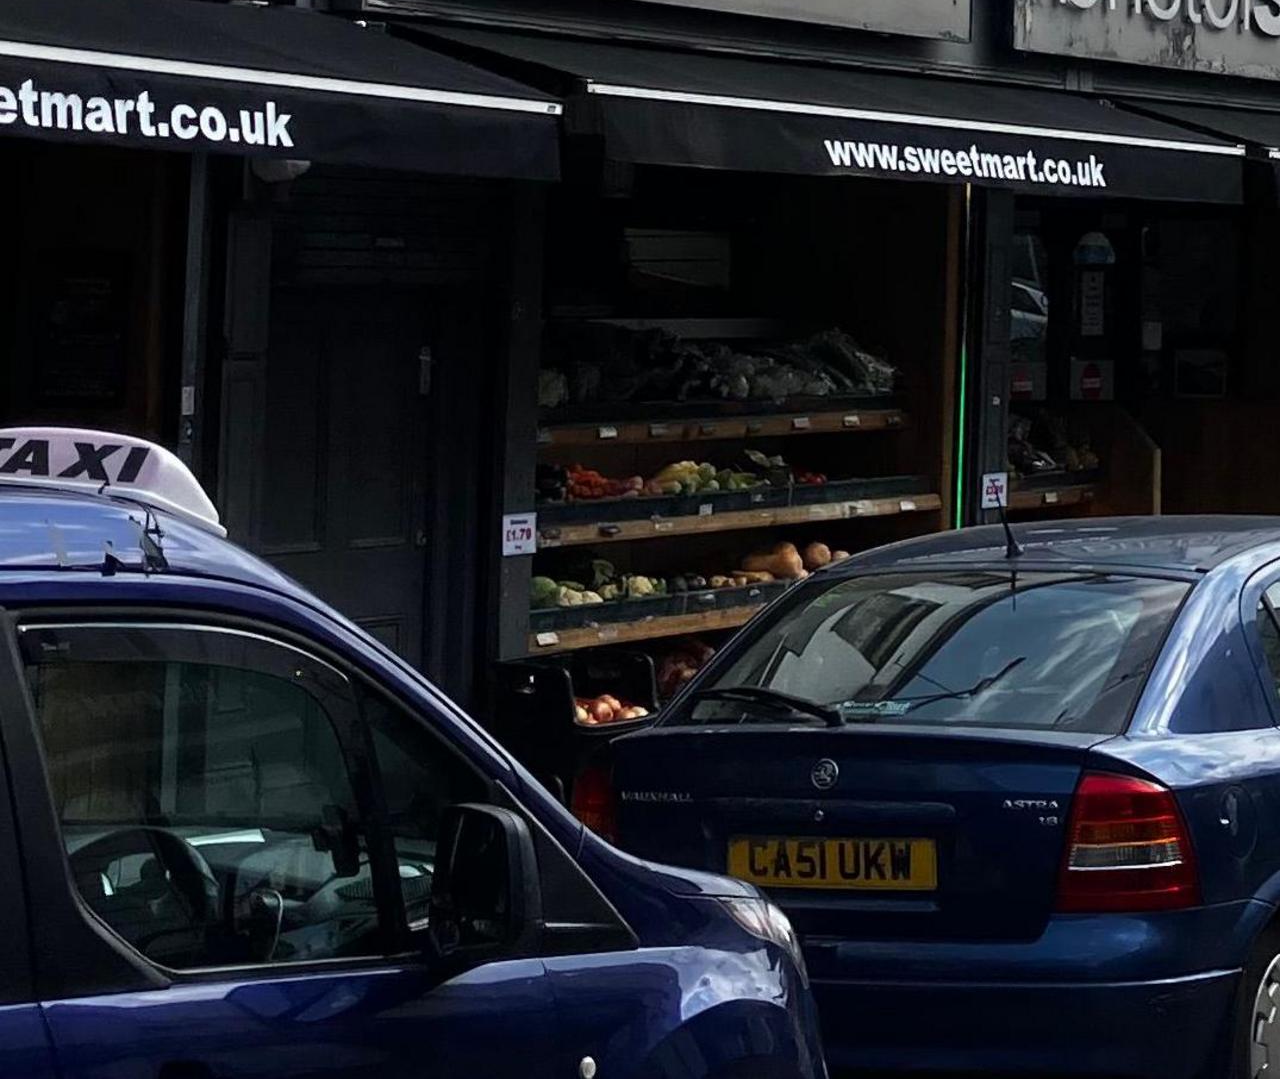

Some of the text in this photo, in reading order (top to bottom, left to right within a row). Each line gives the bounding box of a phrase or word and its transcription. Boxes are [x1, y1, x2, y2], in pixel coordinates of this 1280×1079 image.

[824, 140, 1107, 187] www.sweetmart.co.uk
[620, 790, 695, 802] VAUXHALL
[1002, 799, 1059, 810] ASTRA
[837, 840, 912, 882] UKW
